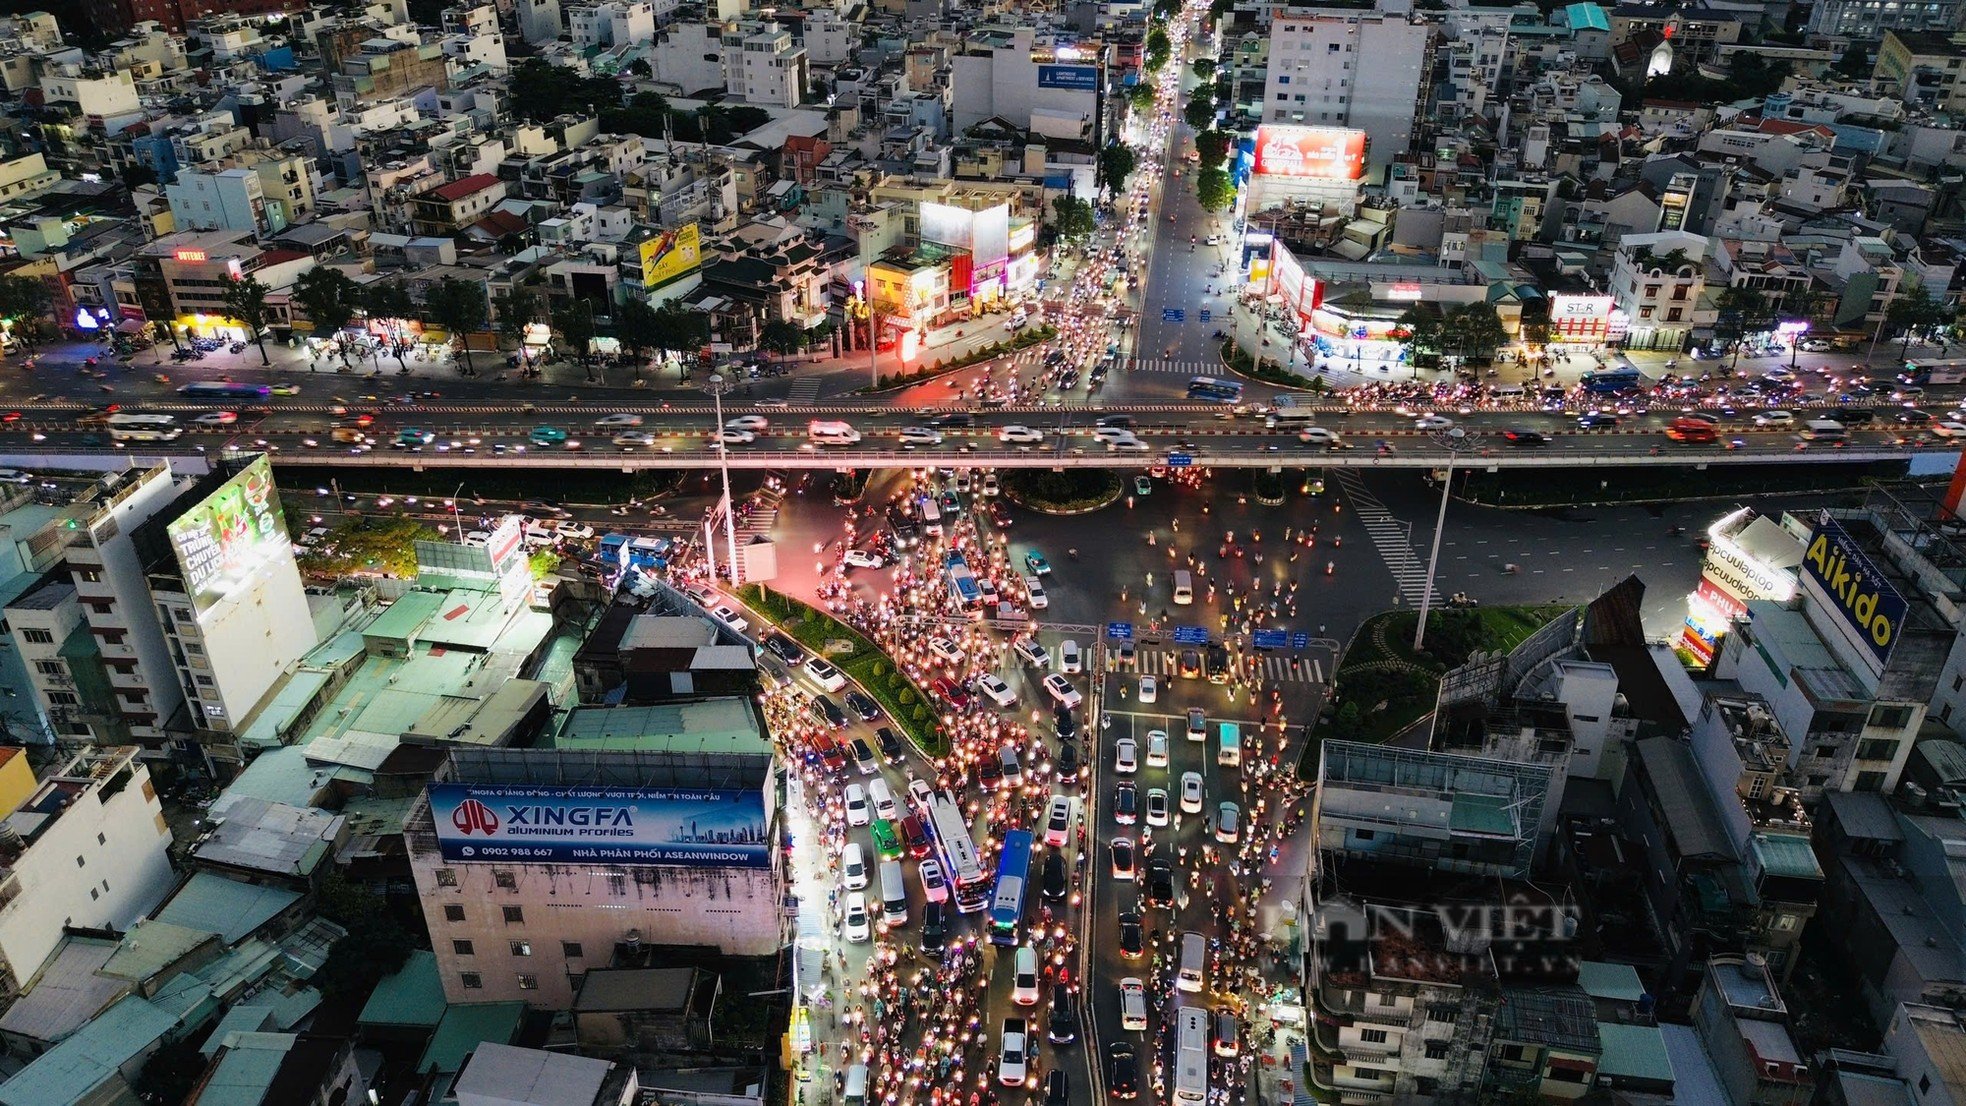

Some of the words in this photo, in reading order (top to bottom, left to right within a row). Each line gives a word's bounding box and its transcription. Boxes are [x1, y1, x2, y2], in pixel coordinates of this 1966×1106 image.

[1806, 533, 1891, 647] Aikido
[467, 788, 495, 797] INGFA
[507, 805, 633, 826] XINGFA
[481, 847, 509, 856] 0902
[510, 848, 531, 857] 988
[533, 849, 553, 857] 667
[573, 847, 597, 857] NHÀ
[600, 848, 631, 859] PHÂN
[634, 848, 661, 859] PHỐI
[664, 851, 749, 861] ASEANWINDOW
